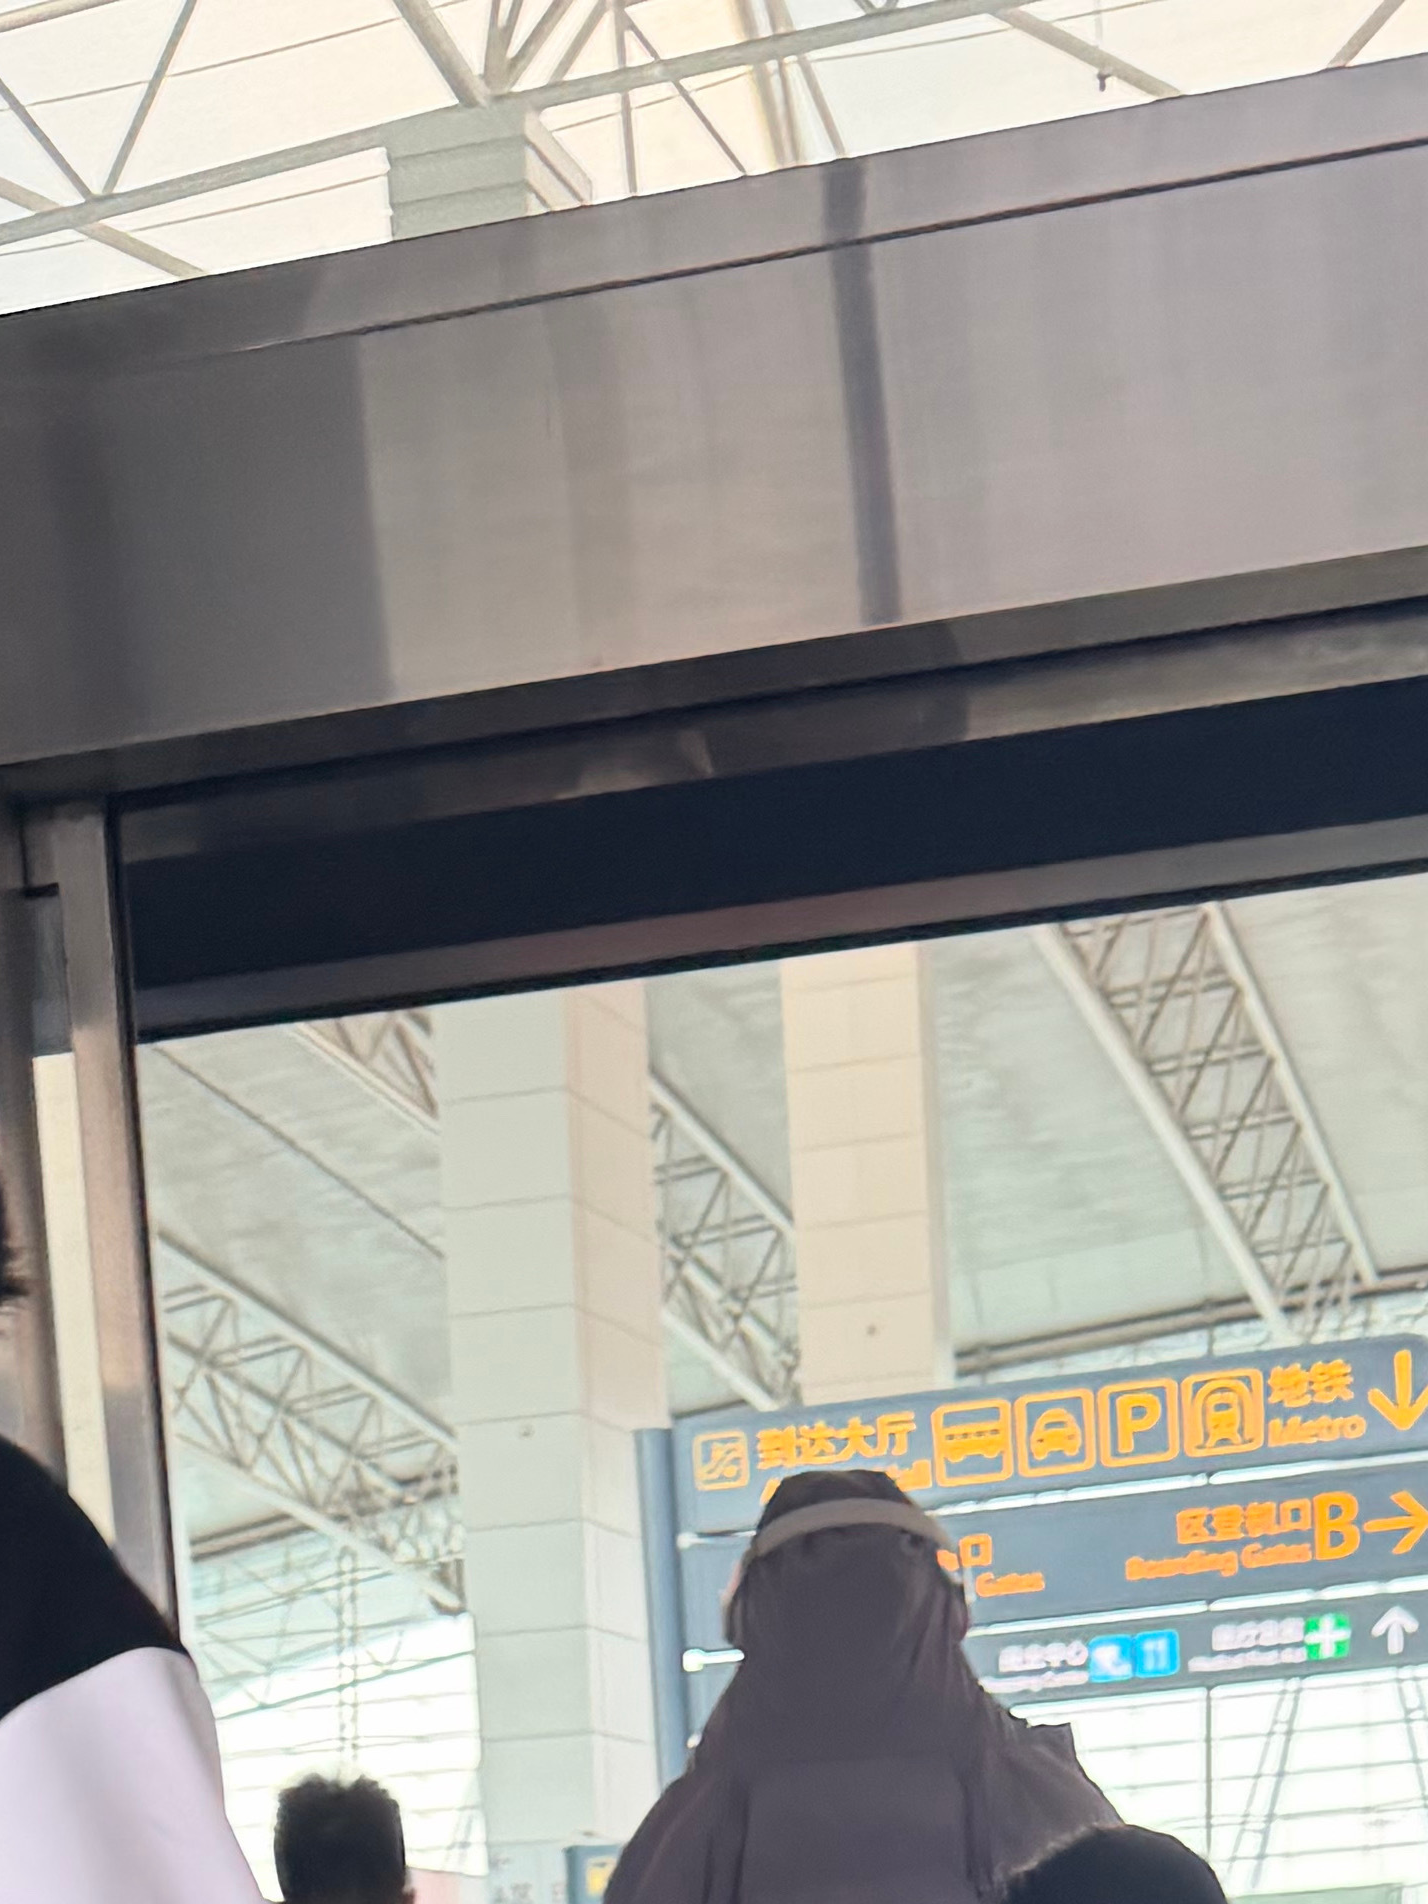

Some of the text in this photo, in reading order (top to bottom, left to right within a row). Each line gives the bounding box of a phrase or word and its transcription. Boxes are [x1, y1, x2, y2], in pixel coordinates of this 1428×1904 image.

[756, 1411, 917, 1470] 到达大厅
[1116, 1393, 1162, 1453] P
[1268, 1414, 1367, 1447] Metro
[1313, 1491, 1360, 1561] B
